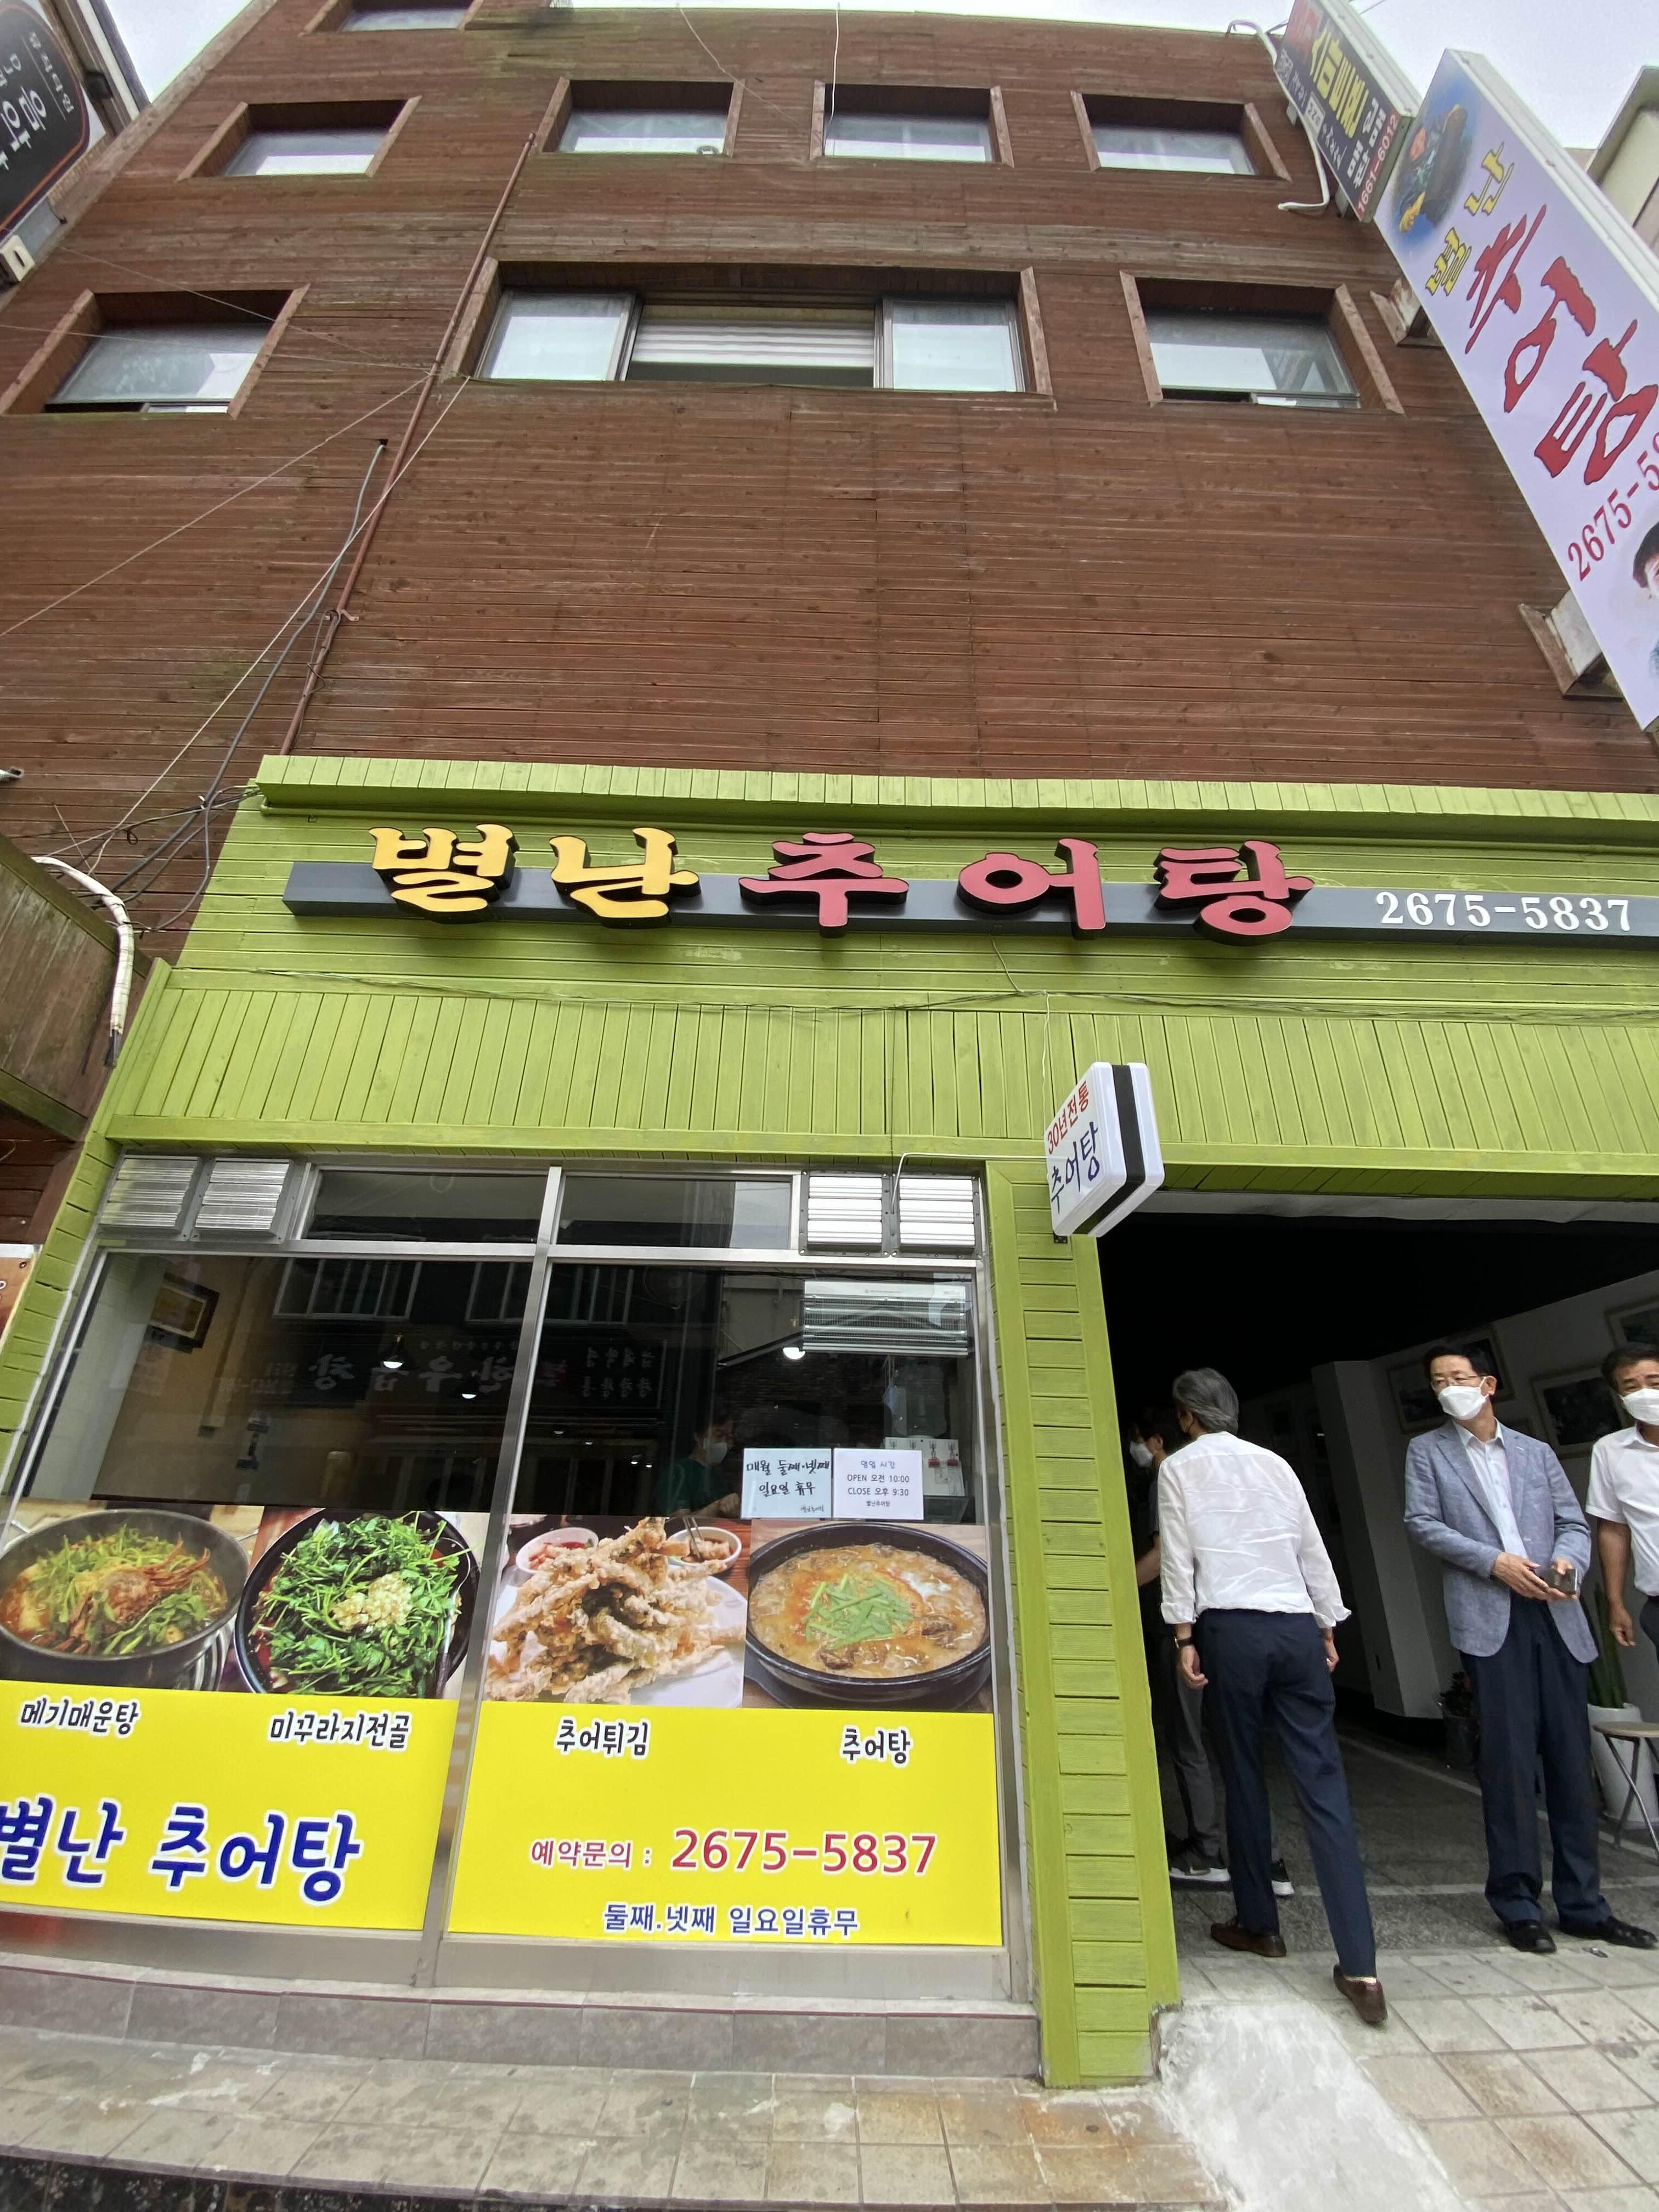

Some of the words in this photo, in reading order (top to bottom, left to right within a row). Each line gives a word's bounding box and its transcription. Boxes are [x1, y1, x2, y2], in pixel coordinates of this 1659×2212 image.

[1353, 108, 1387, 189] 판매
[1358, 114, 1400, 213] 1661-6012
[1425, 142, 1515, 297] 별난
[1465, 204, 1659, 486] 추어탕
[1568, 431, 1659, 582] 2675-5
[369, 823, 701, 928] 별난
[738, 831, 1314, 946] 추어탕
[1376, 891, 1630, 932] 2675-5837
[1047, 1080, 1089, 1155] 30년전통
[1051, 1121, 1101, 1214] 추어탕
[747, 1460, 772, 1476] 매월
[861, 1460, 878, 1469] 영업
[880, 1460, 896, 1469] 시간
[871, 1474, 885, 1482] 오전
[759, 1482, 791, 1497] 일요일
[795, 1482, 816, 1496] 휴무
[874, 1487, 889, 1496] 오후
[893, 1488, 909, 1496] 9:30
[20, 1698, 139, 1735] 메기매운탕
[270, 1712, 410, 1750] 미꾸라지전골
[556, 1719, 650, 1756] 추어튀김
[842, 1728, 911, 1765] 추어탕
[0, 1796, 126, 1884] 별난
[151, 1806, 363, 1902] 추어탕
[531, 1839, 632, 1869] 예약문의
[672, 1830, 937, 1874] 2675-5837
[730, 1907, 858, 1936] 일요일휴무
